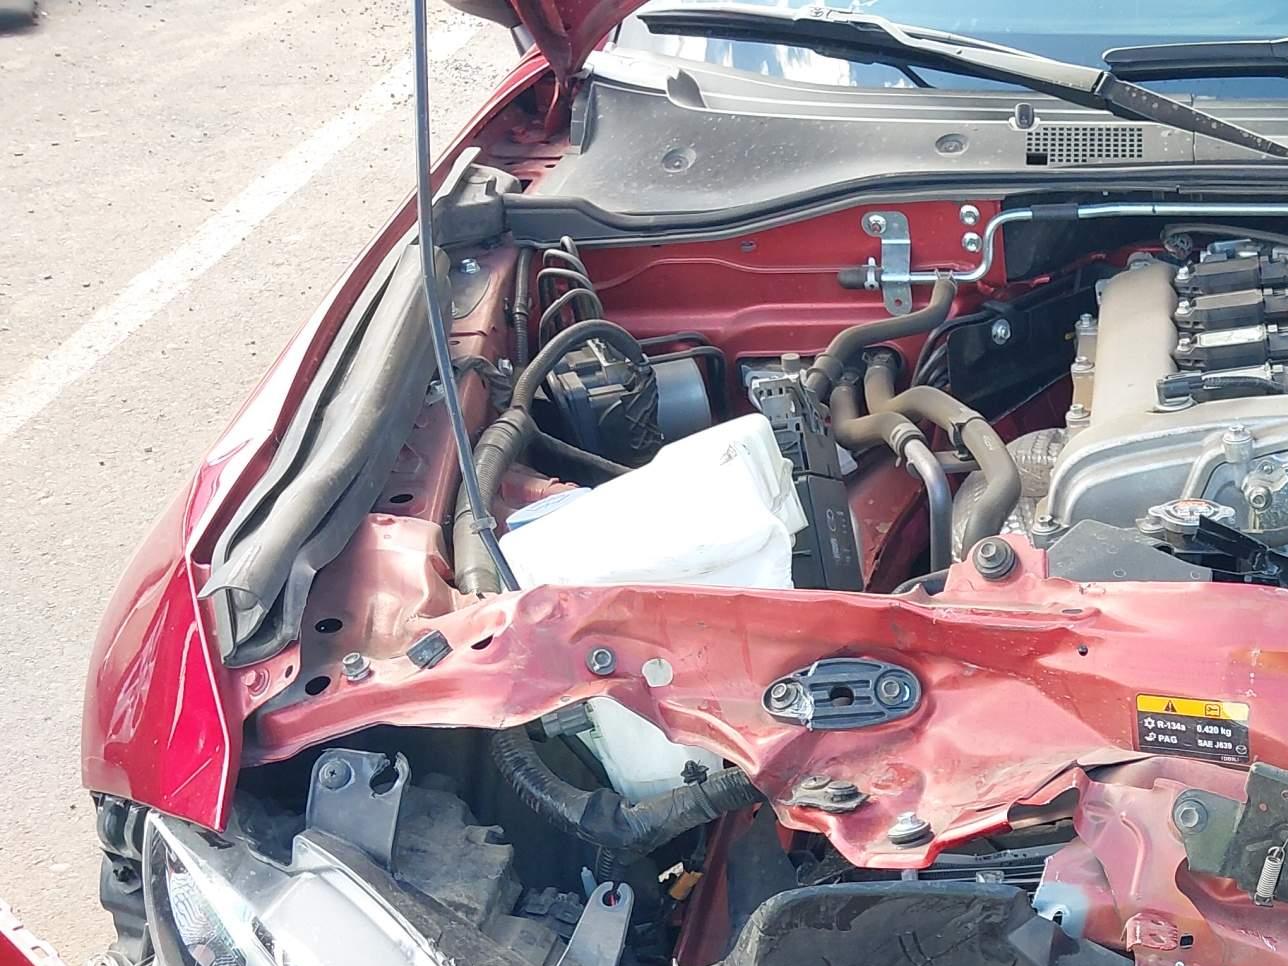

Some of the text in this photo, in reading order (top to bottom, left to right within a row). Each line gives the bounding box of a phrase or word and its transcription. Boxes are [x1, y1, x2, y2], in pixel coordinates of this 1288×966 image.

[1157, 720, 1232, 737] R-134a 0.420 kg
[1158, 735, 1178, 743] PAG
